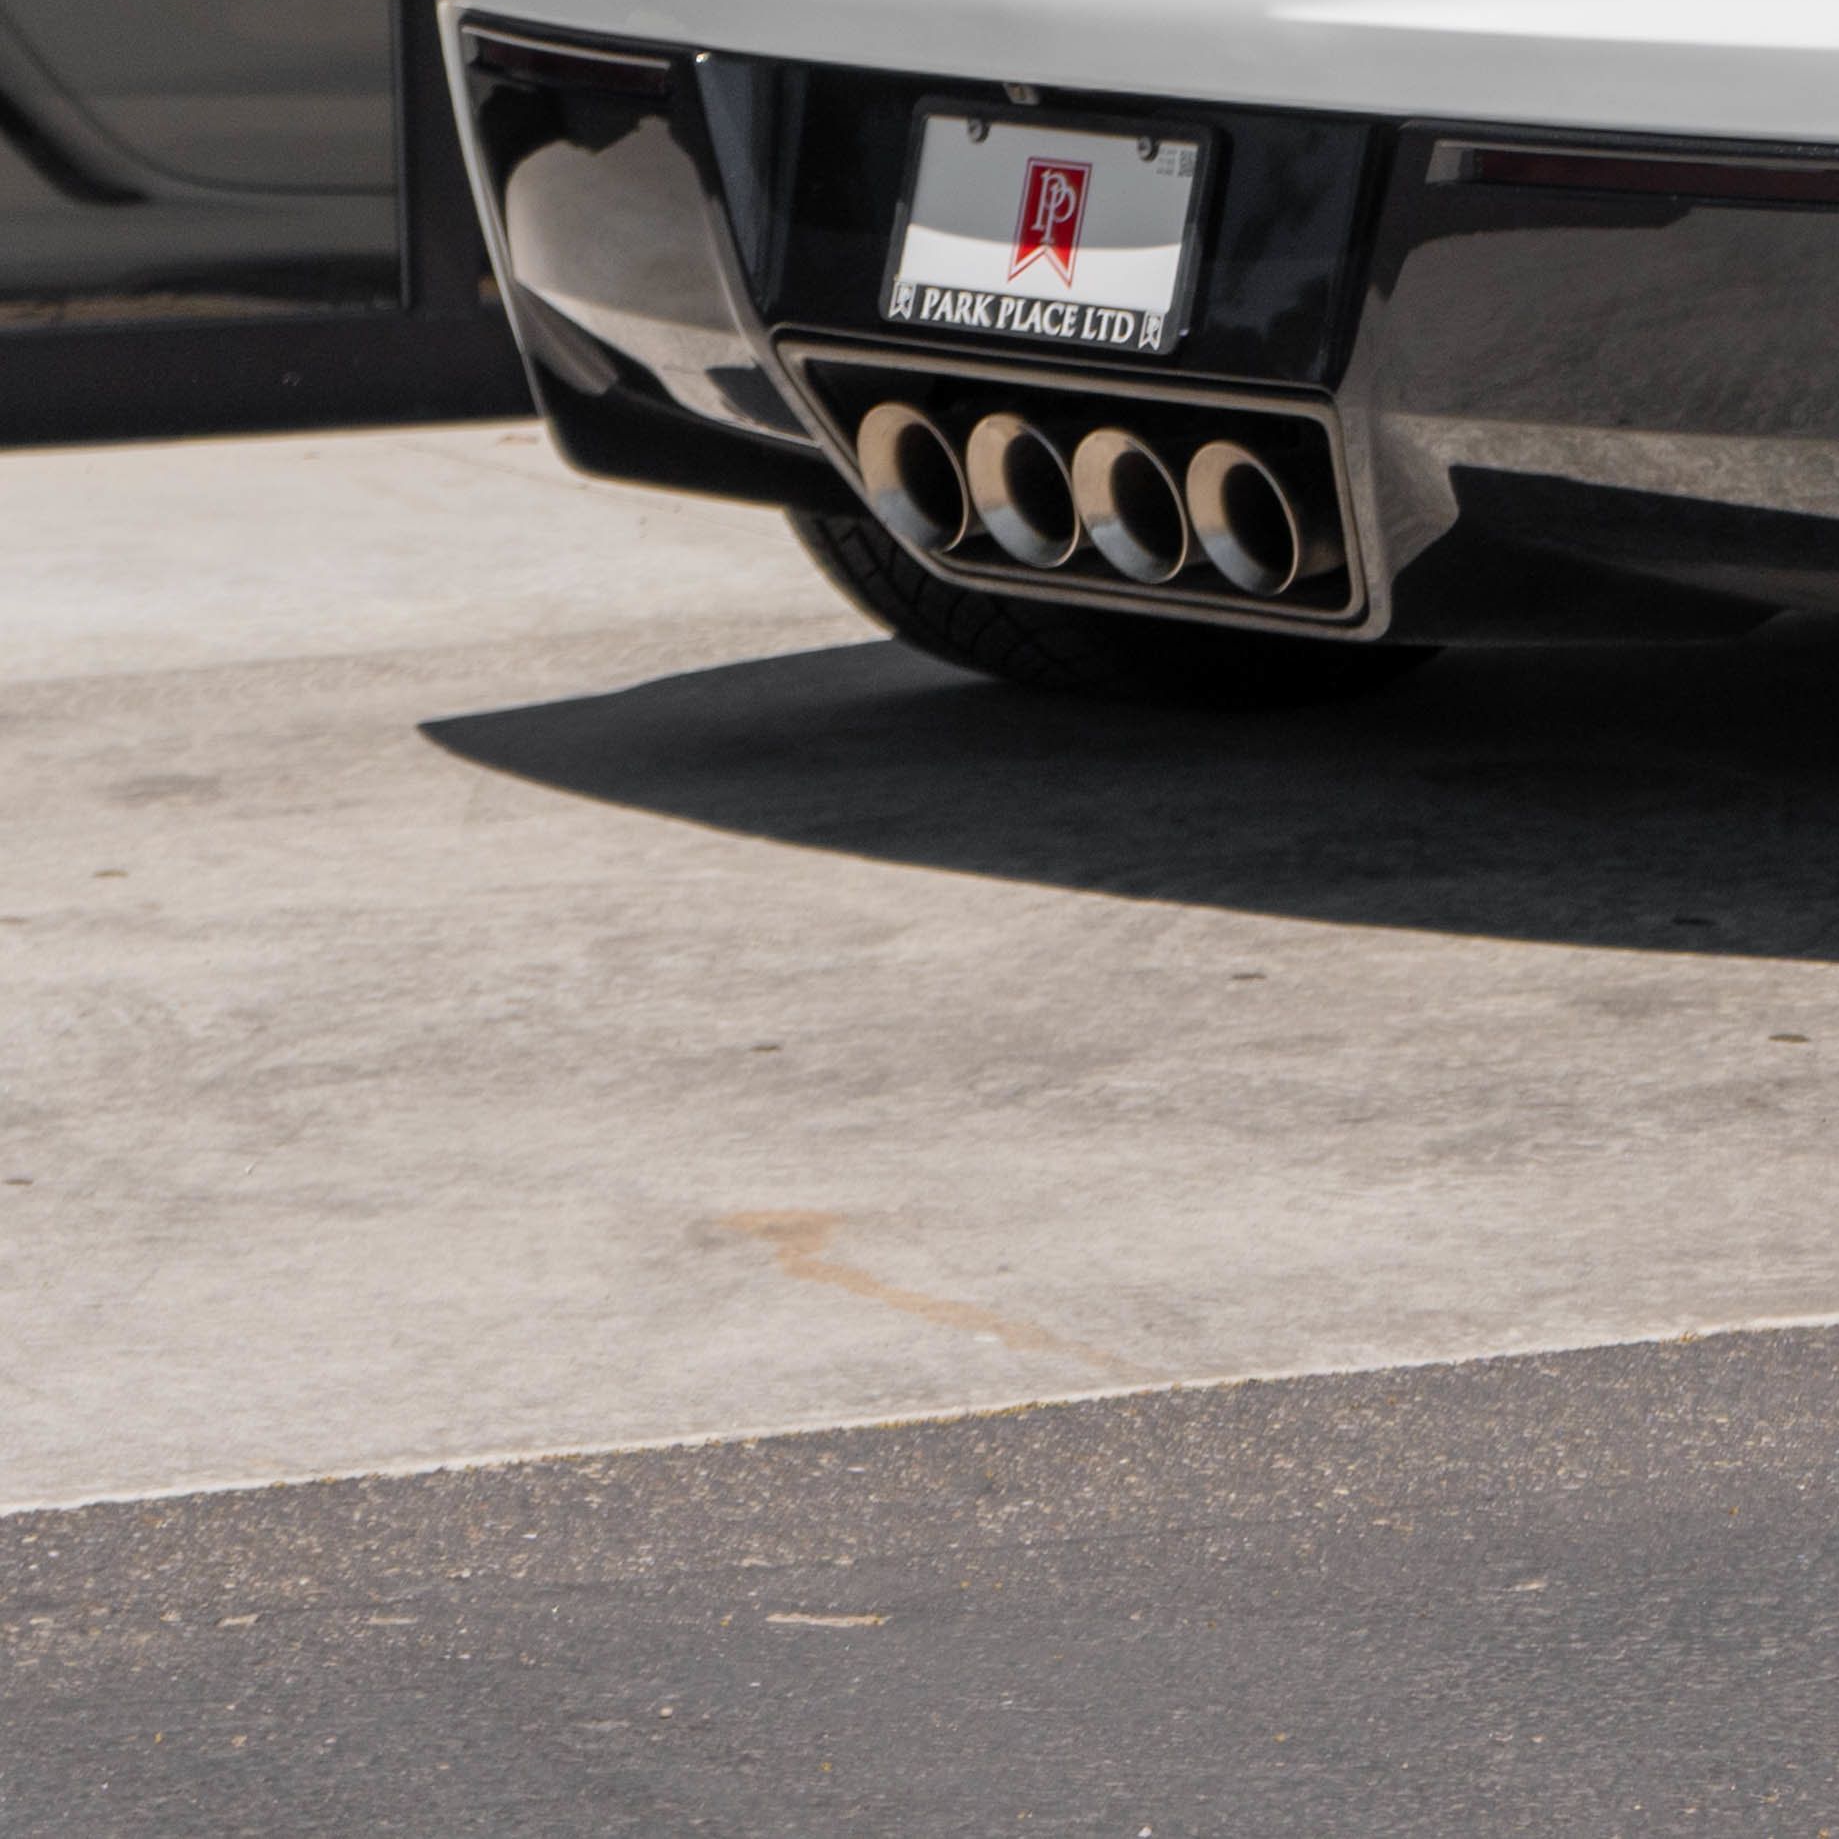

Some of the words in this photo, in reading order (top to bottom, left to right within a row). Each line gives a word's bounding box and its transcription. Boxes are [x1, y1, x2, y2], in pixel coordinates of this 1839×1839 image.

[920, 288, 995, 329] PARK
[996, 297, 1077, 339] PLACE
[1081, 308, 1135, 344] LTD
